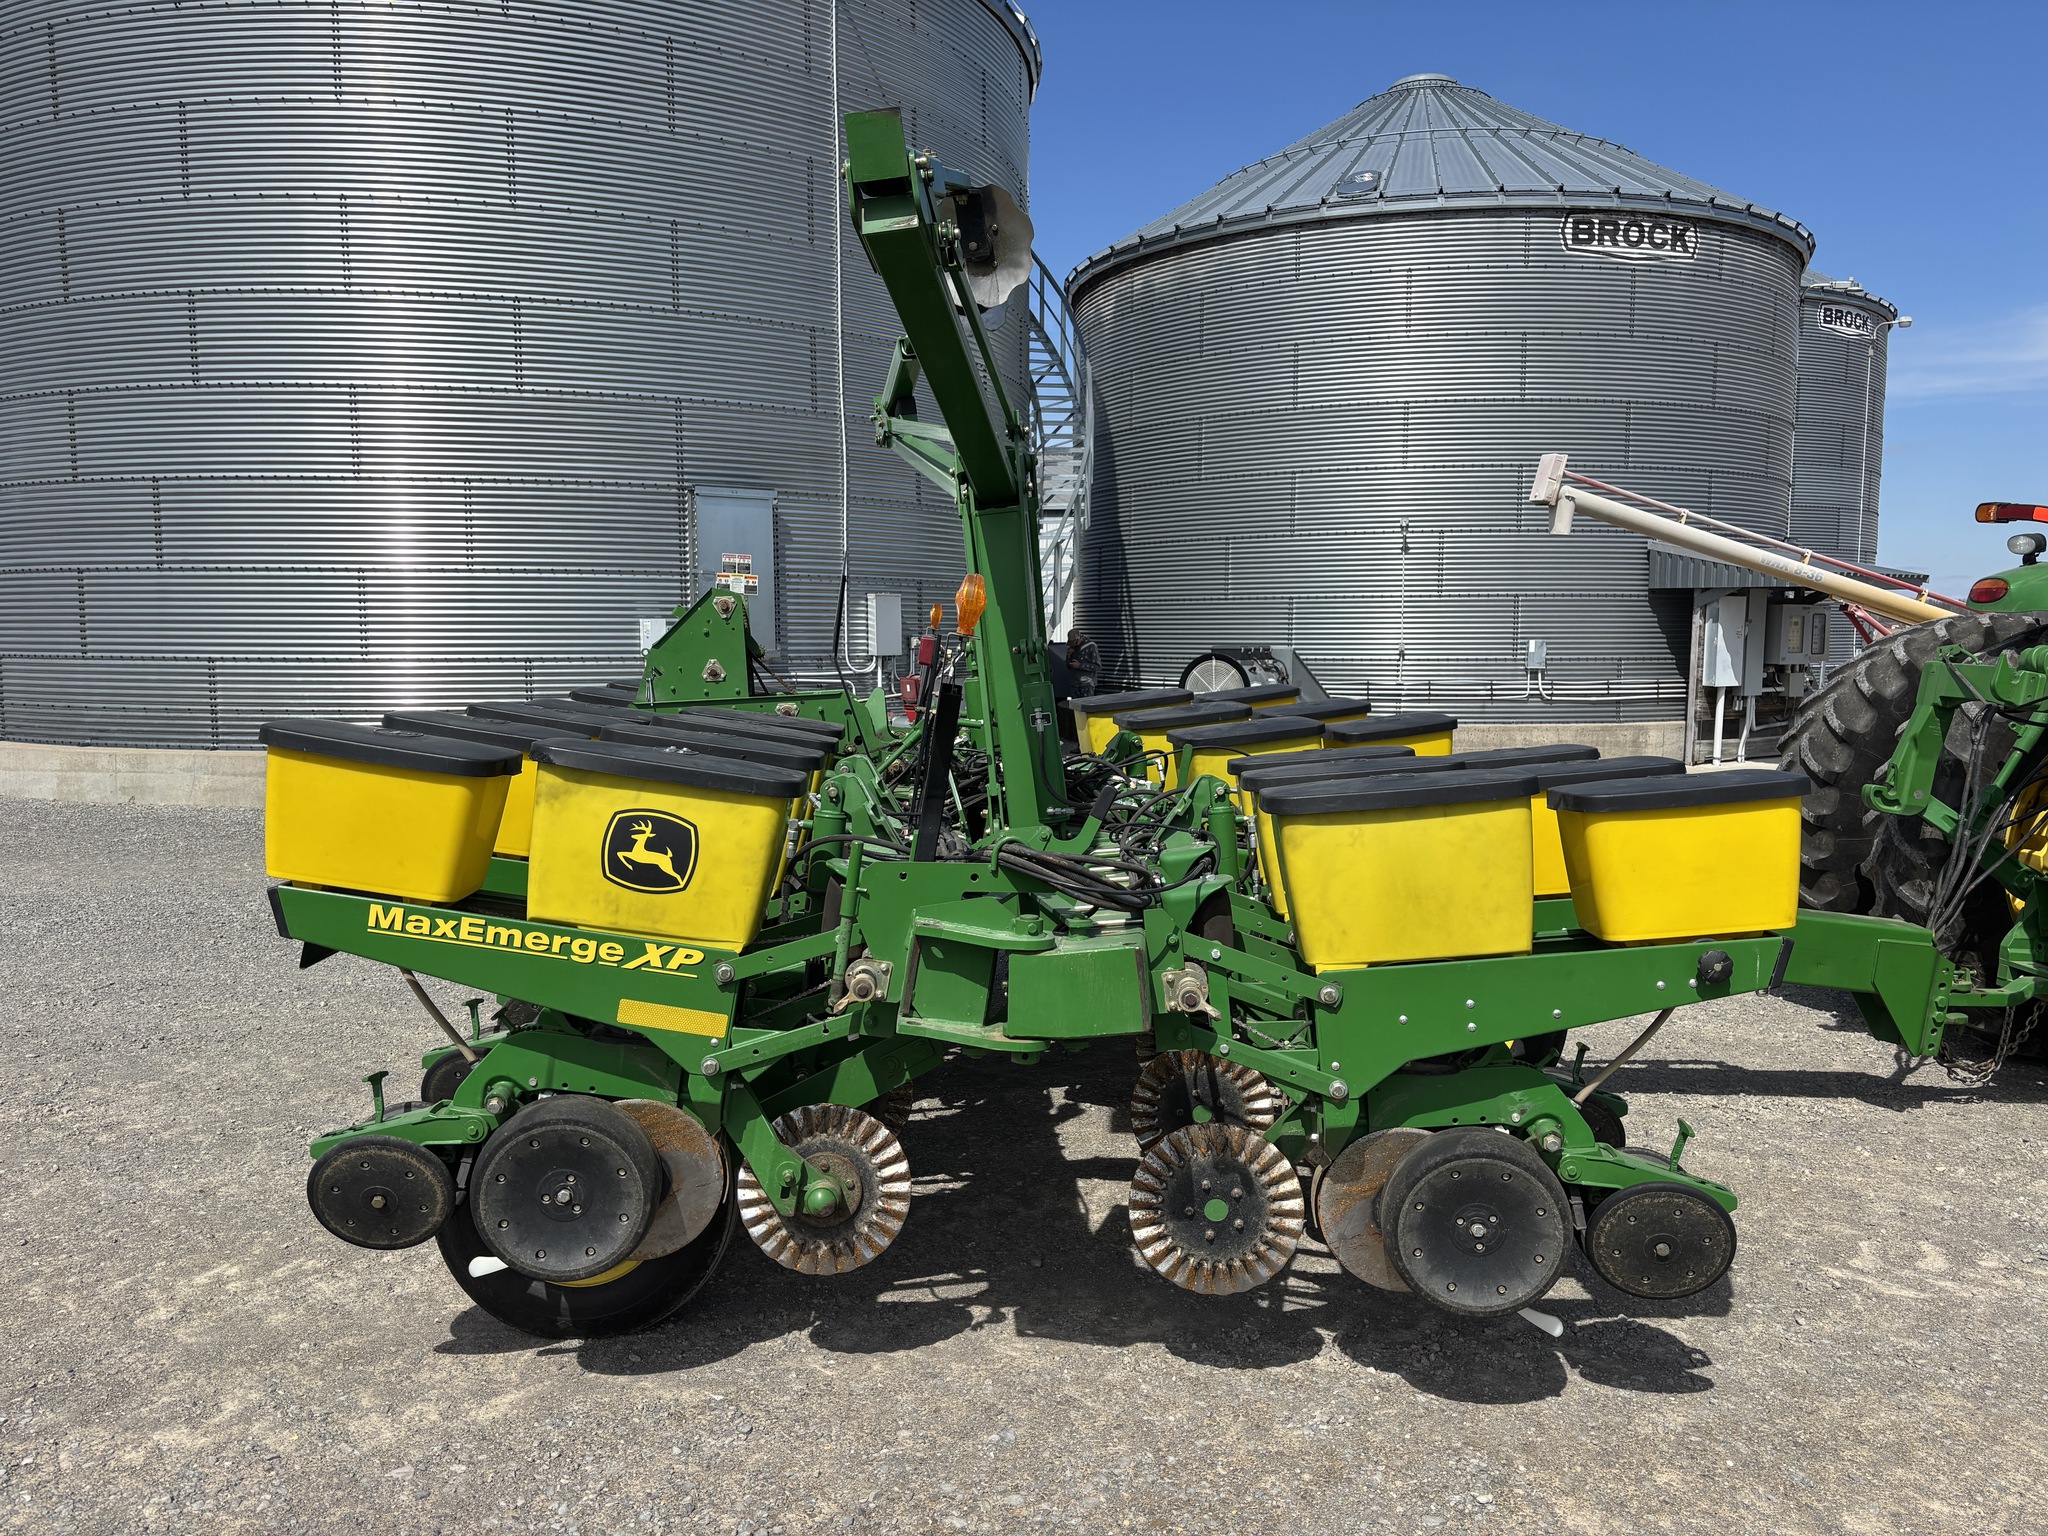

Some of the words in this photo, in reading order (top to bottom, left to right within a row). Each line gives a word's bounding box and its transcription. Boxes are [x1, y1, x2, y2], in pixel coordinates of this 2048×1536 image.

[1571, 217, 1692, 253] BROCK
[1823, 307, 1870, 332] BROCK
[1793, 565, 1824, 583] 8-36
[368, 903, 625, 964] MaxEmerge
[622, 943, 706, 971] XP
